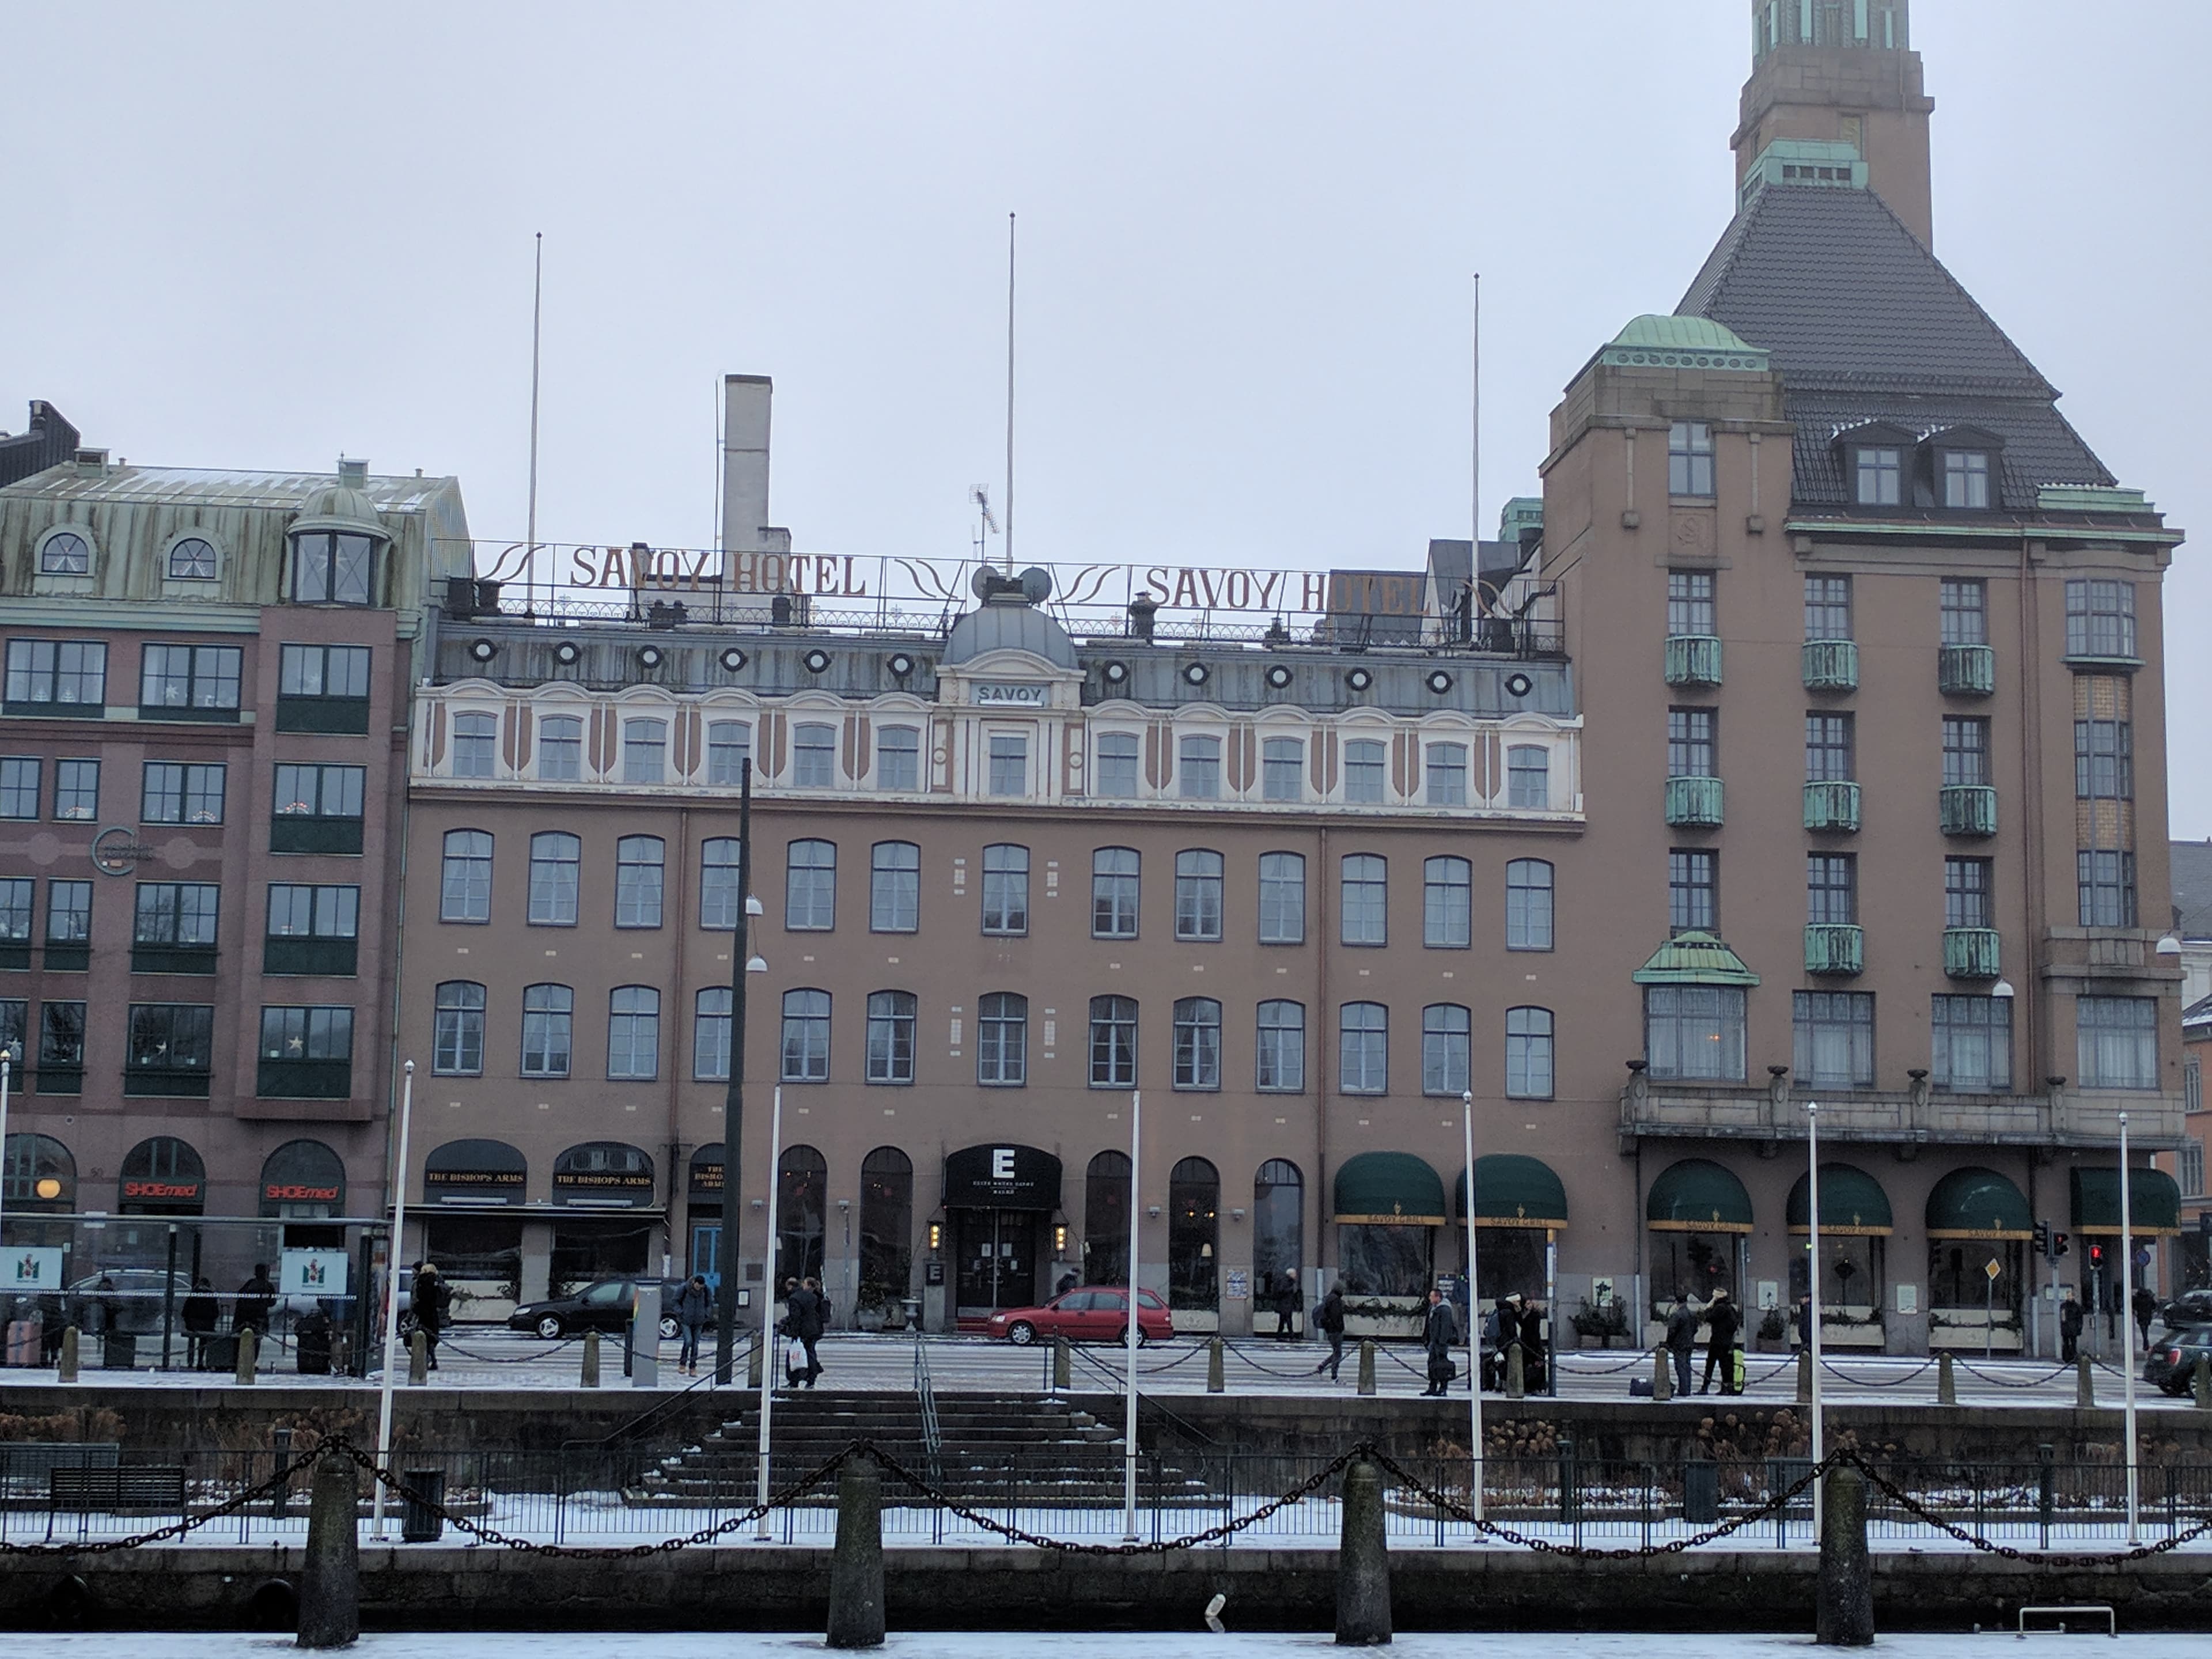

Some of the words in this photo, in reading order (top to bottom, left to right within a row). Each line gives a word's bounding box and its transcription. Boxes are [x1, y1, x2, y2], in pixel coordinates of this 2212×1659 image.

[570, 547, 710, 590] SAVOY
[733, 553, 866, 595] HOTEL
[1147, 568, 1279, 609] SAVOY
[1301, 574, 1430, 615] HOTEL
[979, 686, 1041, 702] SAVOY
[993, 1149, 1015, 1179] E
[429, 1173, 448, 1181] THE
[494, 1174, 524, 1182] ARMS
[557, 1175, 575, 1183] THE
[623, 1177, 651, 1185] ARMS
[1367, 1214, 1395, 1223] SAVOY
[1490, 1217, 1519, 1226] SAVOY
[1685, 1220, 1715, 1230] SAVOY
[1968, 1229, 1997, 1238] SAVOY
[930, 1266, 940, 1279] E
